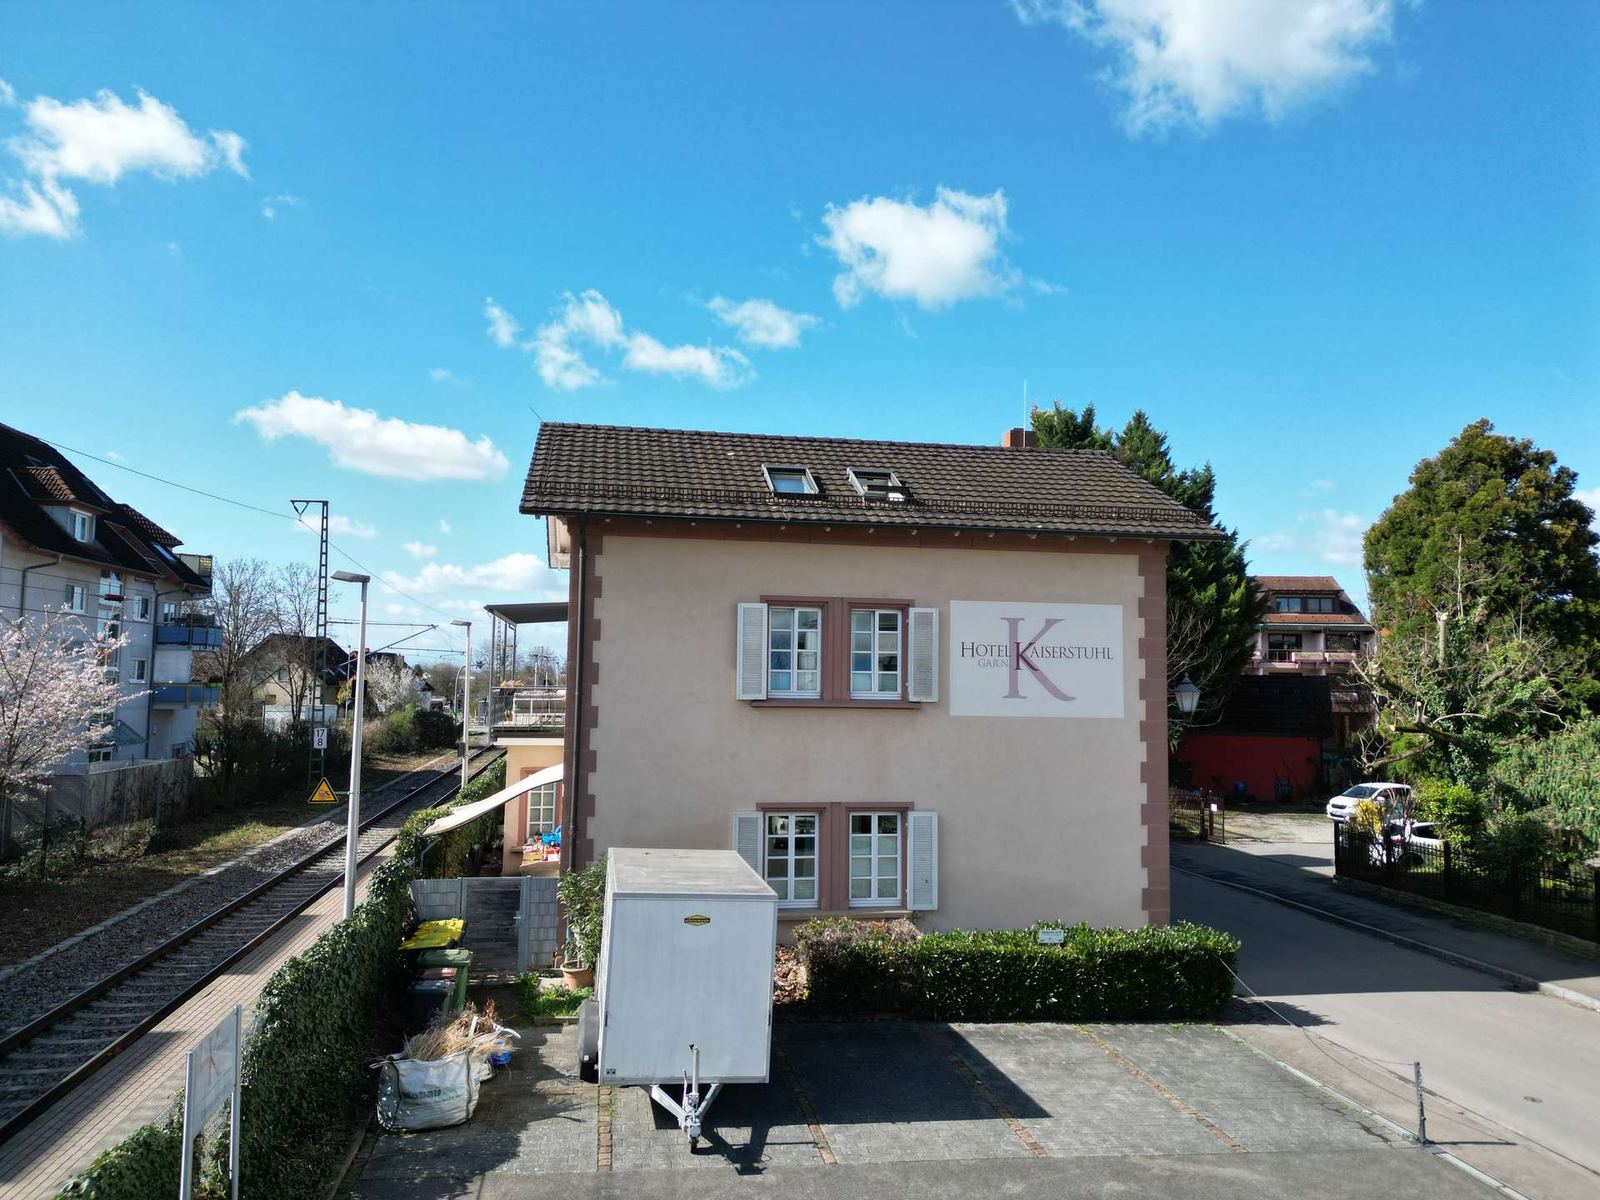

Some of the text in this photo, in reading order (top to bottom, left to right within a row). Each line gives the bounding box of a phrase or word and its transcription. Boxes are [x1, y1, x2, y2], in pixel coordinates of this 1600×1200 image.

[960, 641, 1012, 658] HOTEL
[1000, 617, 1077, 701] K
[316, 729, 325, 738] 17
[317, 738, 323, 746] 8
